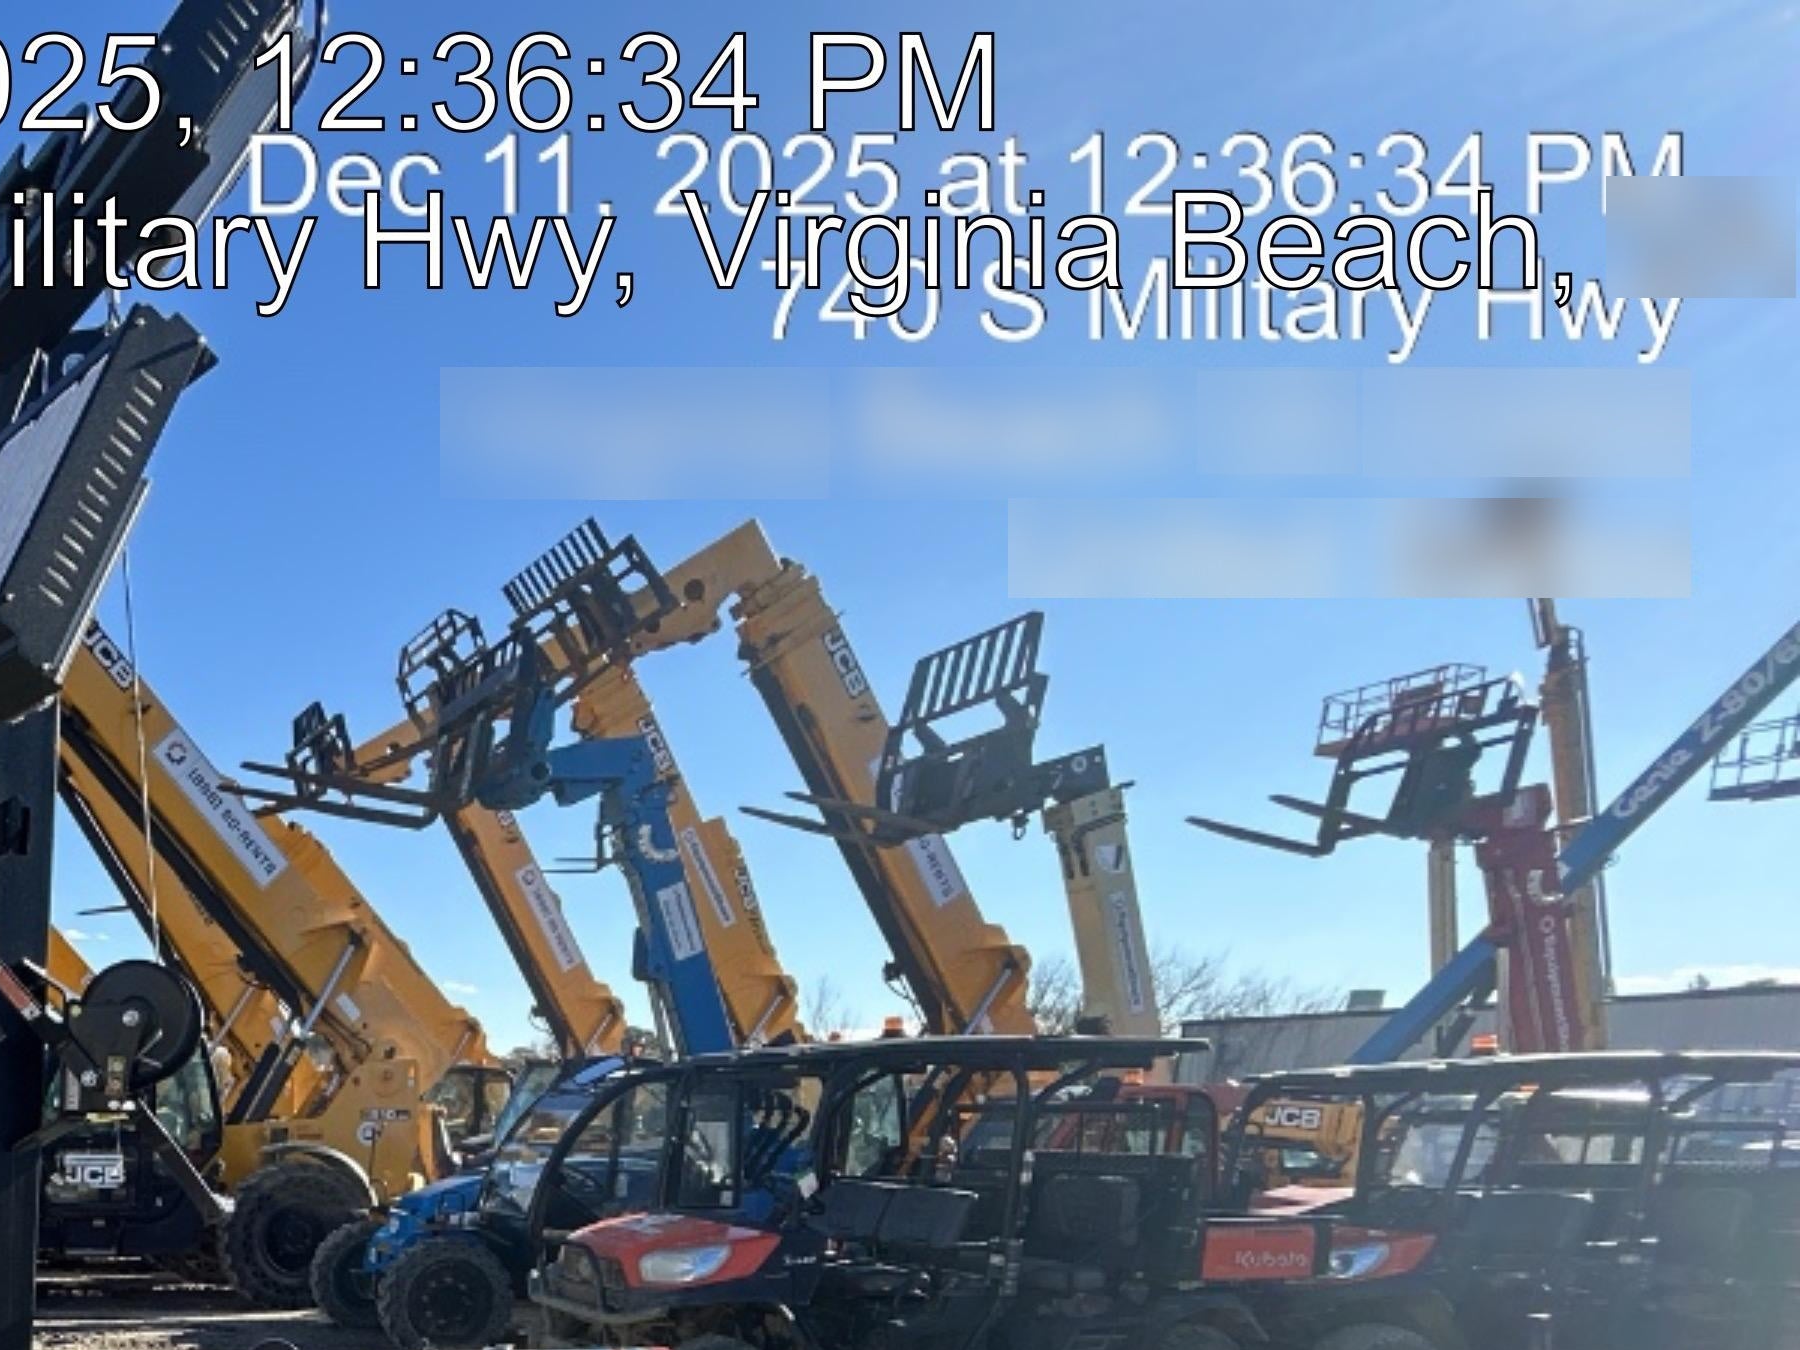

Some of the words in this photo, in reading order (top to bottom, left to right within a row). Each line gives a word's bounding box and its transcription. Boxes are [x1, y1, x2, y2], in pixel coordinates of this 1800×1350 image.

[81, 627, 136, 691] JCB
[824, 631, 867, 698] JCB
[1264, 1106, 1321, 1129] JCB
[65, 1165, 125, 1184] JCB
